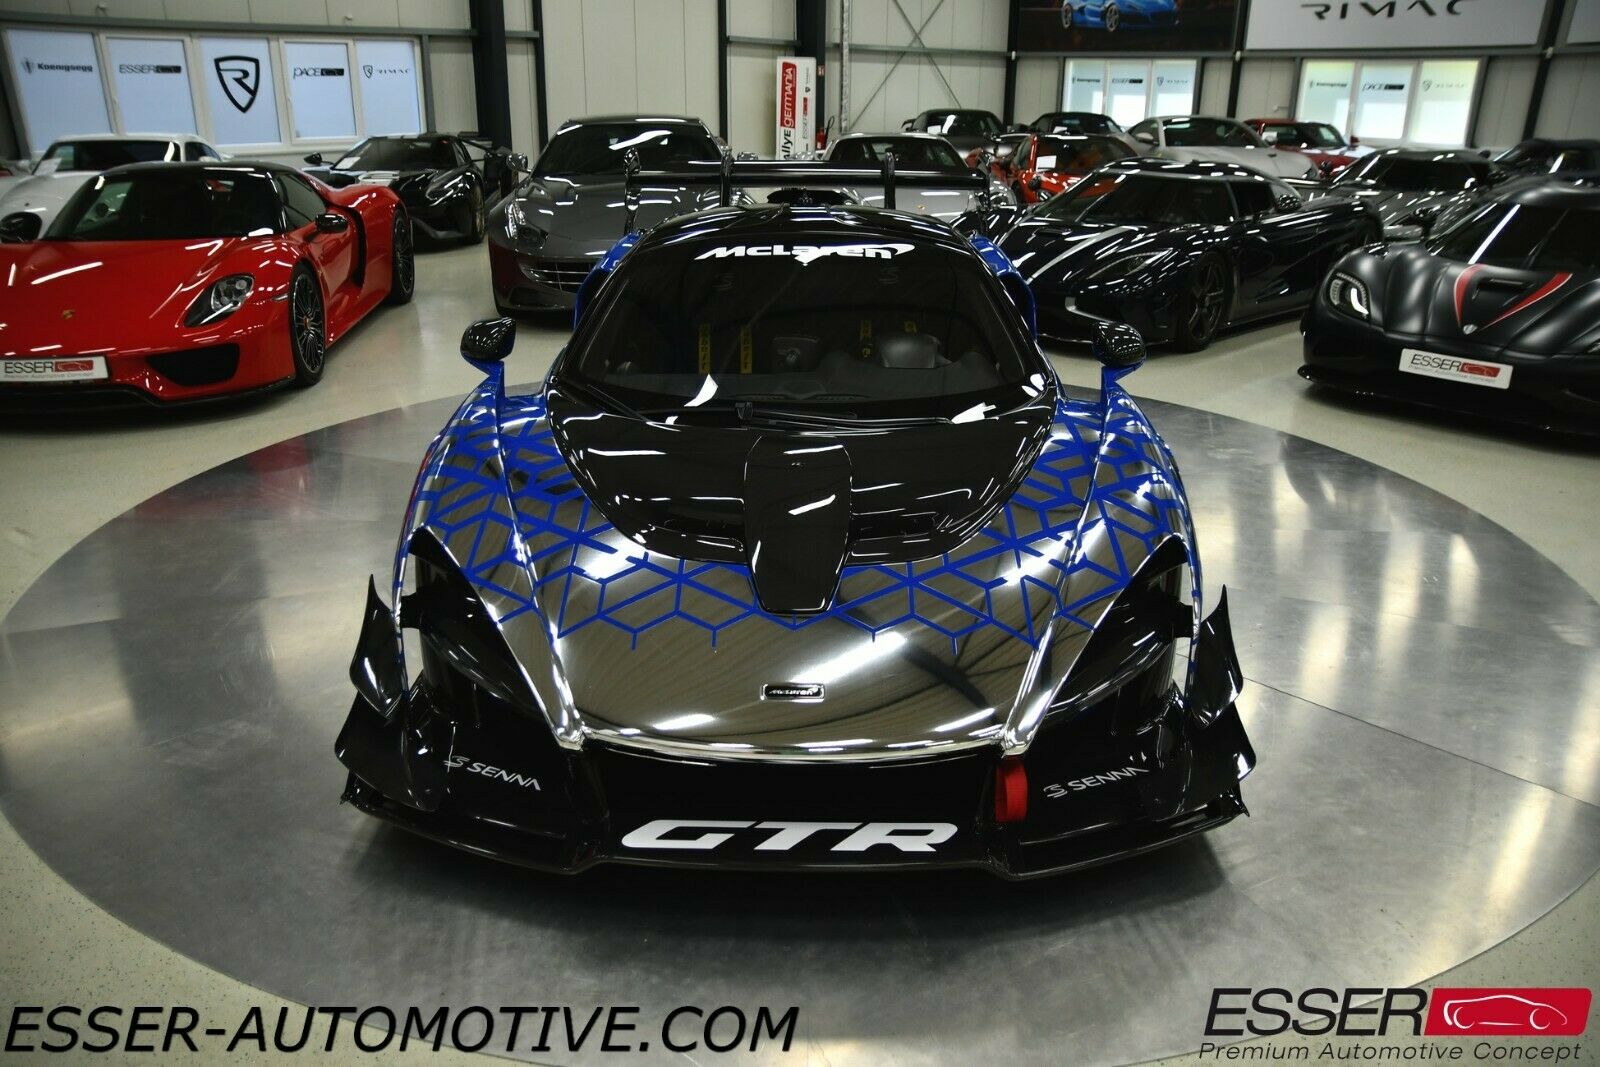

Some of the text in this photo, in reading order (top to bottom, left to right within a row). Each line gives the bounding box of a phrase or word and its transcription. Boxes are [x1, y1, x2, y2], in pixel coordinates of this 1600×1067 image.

[1301, 0, 1462, 20] RIMAC
[37, 62, 94, 73] Koenigsegg
[119, 64, 156, 74] ESSER
[4, 361, 55, 374] ESSER
[1410, 353, 1462, 372] ESSER
[466, 762, 542, 791] SENNA
[1067, 766, 1150, 791] SENNA
[621, 819, 959, 852] GTR
